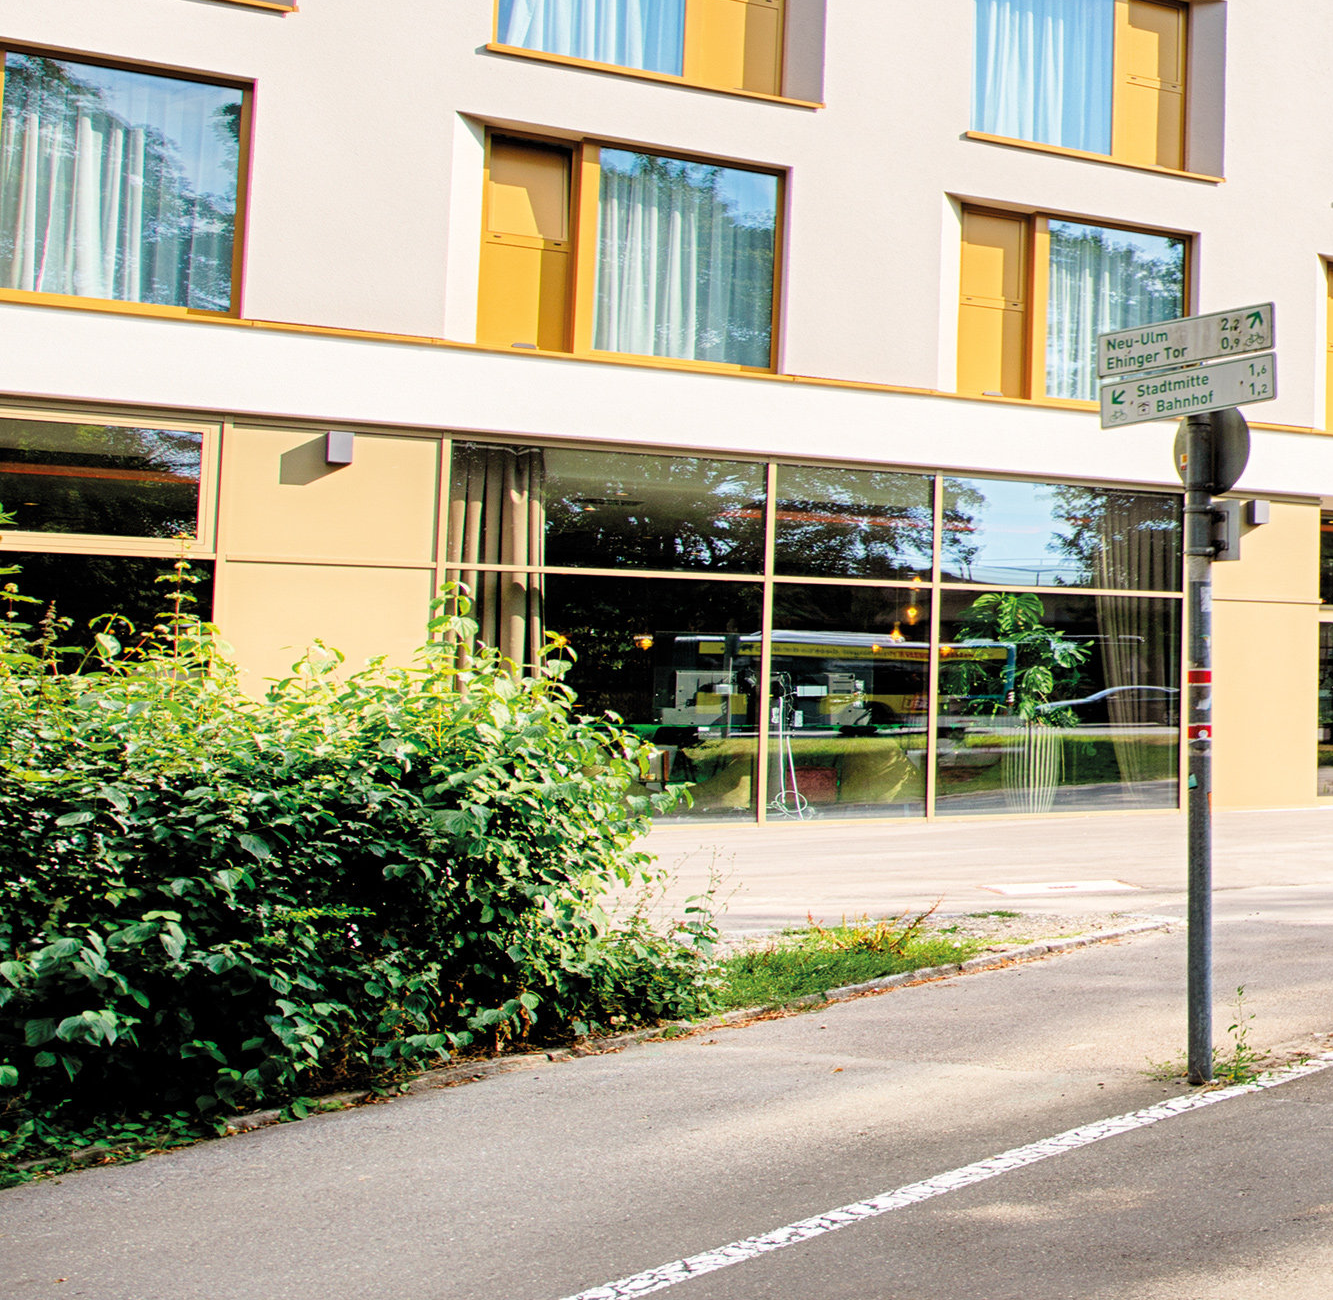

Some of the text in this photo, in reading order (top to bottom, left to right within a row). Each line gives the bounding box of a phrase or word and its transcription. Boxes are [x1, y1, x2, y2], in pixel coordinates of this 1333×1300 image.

[1106, 318, 1240, 351] Neu-Ulm 2,2
[1106, 337, 1240, 371] Ehinger Tor 0,9
[1137, 363, 1267, 398] Stadtmitte 1,6
[1156, 383, 1268, 413] Bahnhof 1,2
